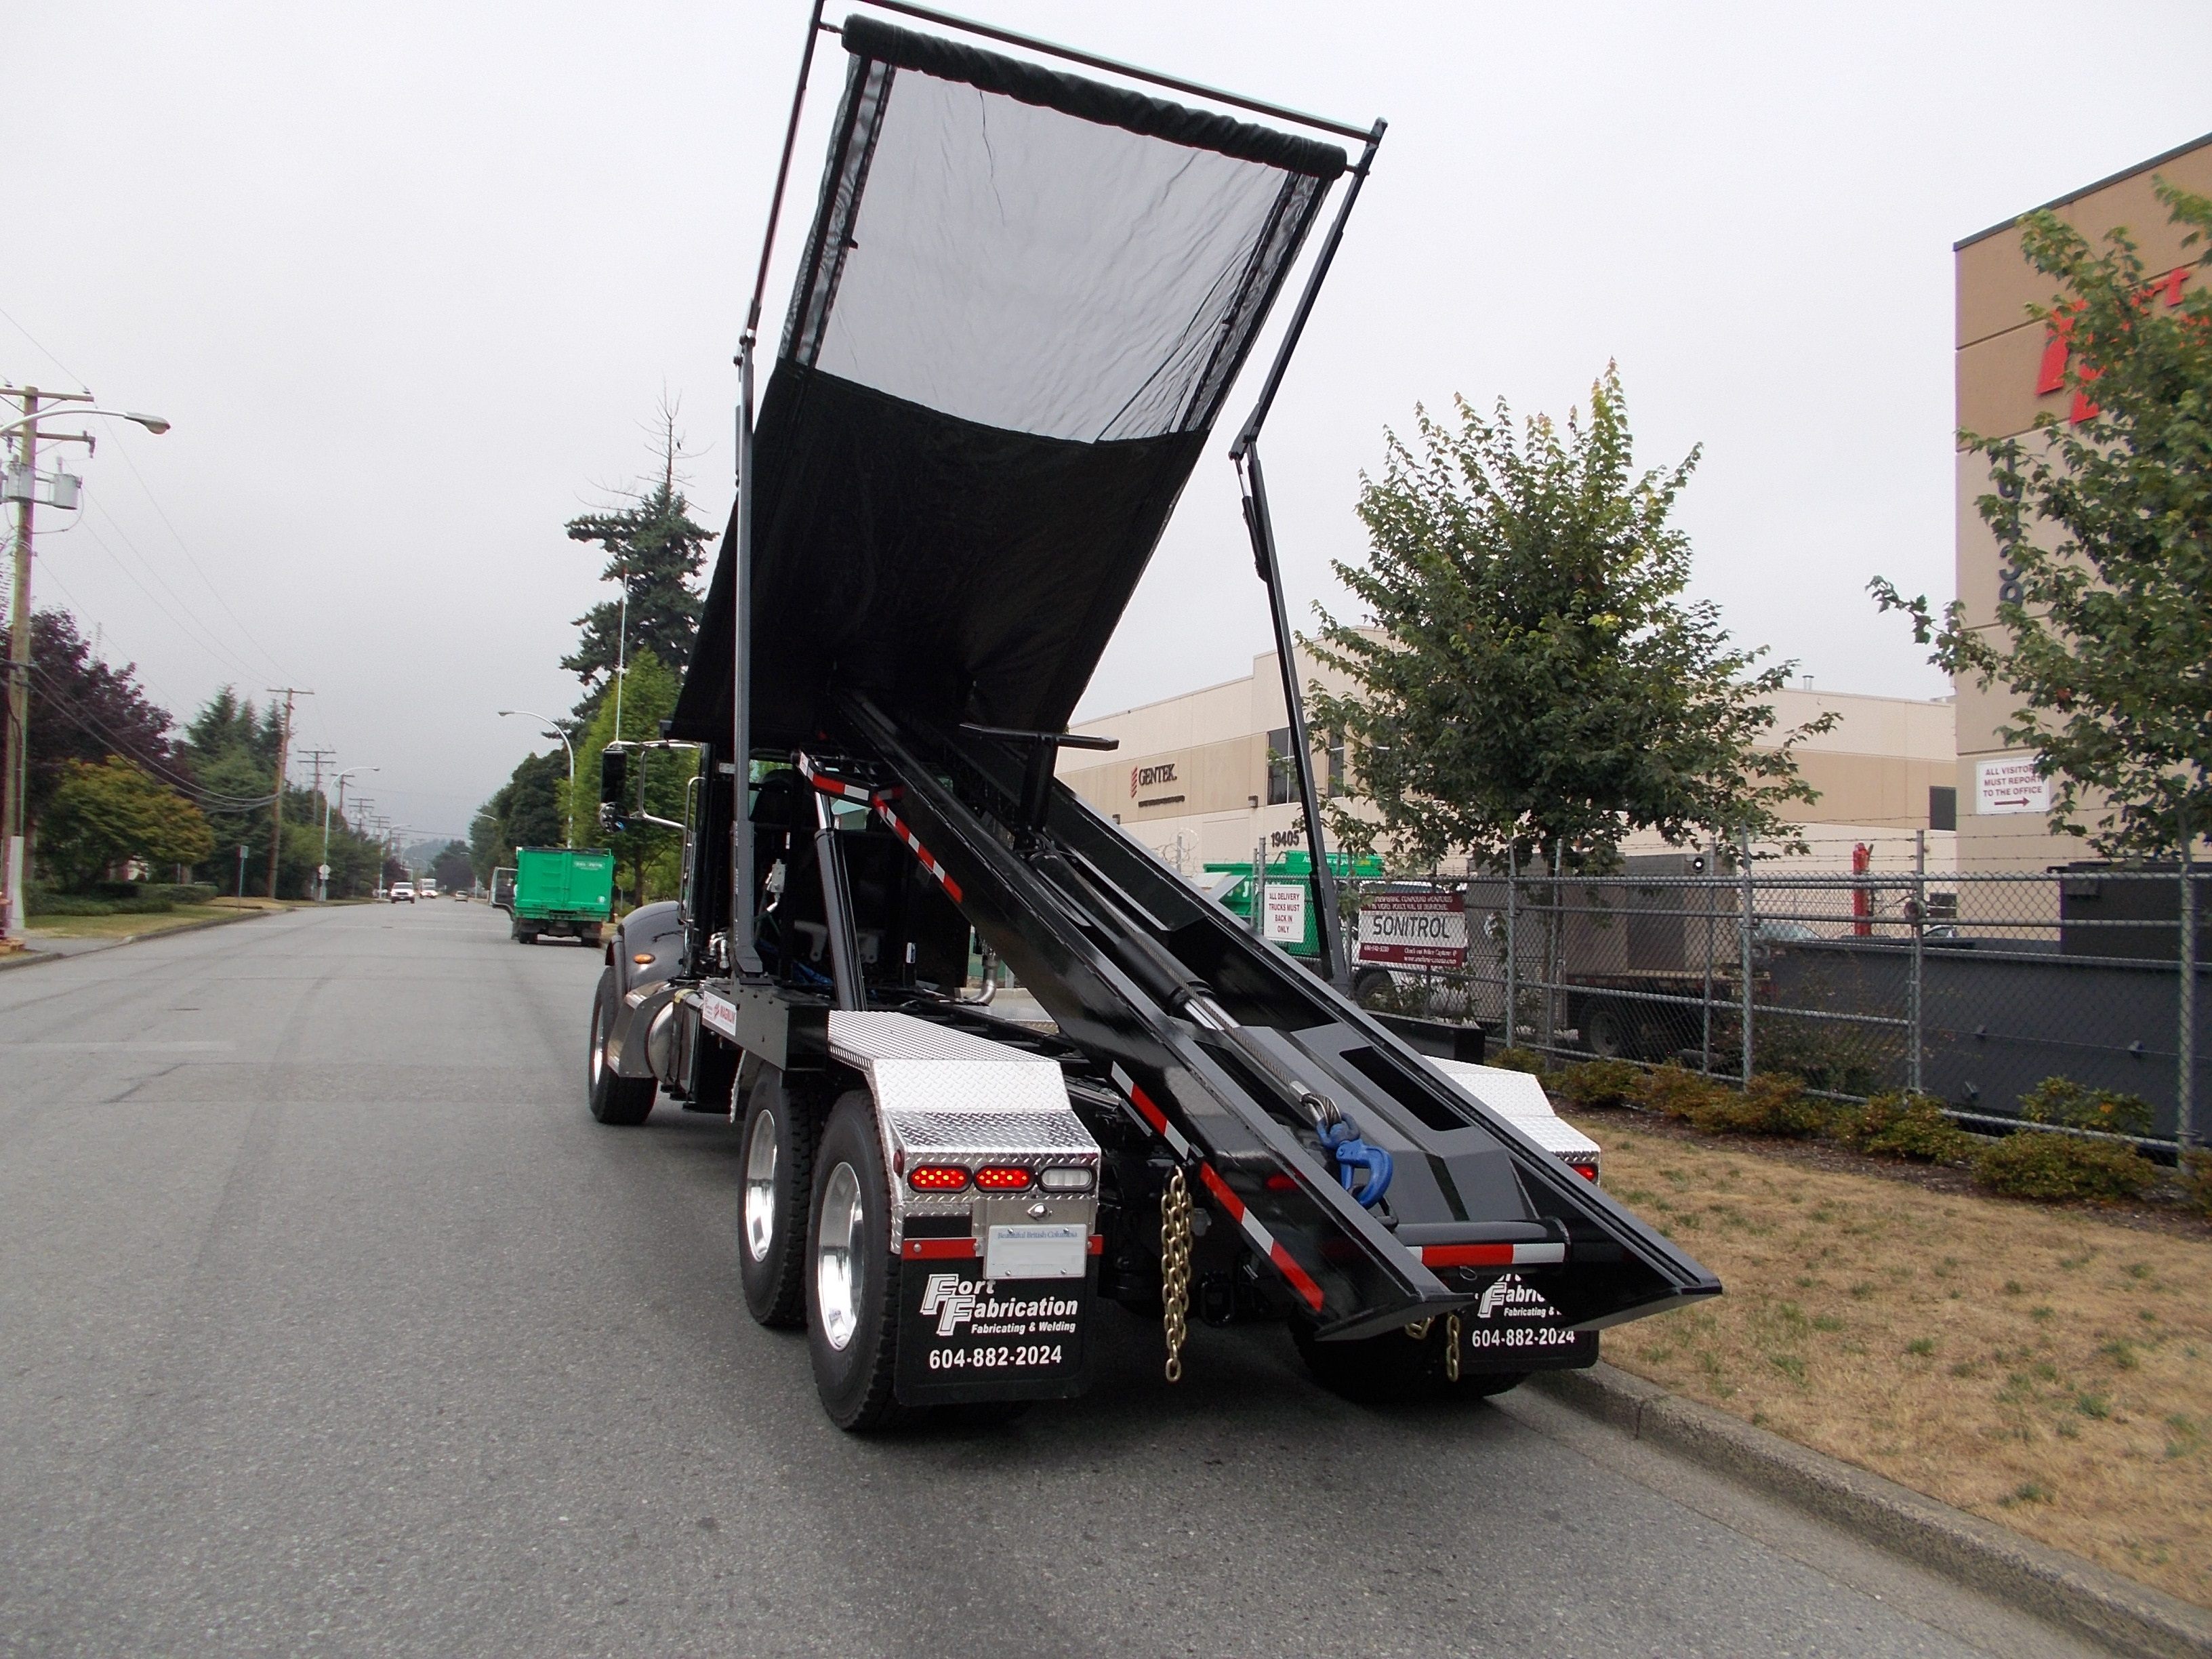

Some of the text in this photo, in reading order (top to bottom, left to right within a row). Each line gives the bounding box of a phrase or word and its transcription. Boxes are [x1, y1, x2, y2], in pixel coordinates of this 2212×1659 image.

[2001, 764, 2034, 775] VISITOR
[1984, 775, 2042, 786] MUST REPORT
[2013, 786, 2043, 795] OFFICE
[1271, 830, 1299, 847] 19405
[1277, 925, 1290, 933] ONLY
[1373, 915, 1450, 939] SONITROL
[1027, 1231, 1046, 1239] British
[920, 1274, 996, 1315] Fort
[936, 1295, 1078, 1336] Fabrication
[1503, 1307, 1547, 1317] Fabricating
[1549, 1306, 1555, 1315] &
[971, 1321, 1076, 1334] Fabricating & Welding
[1472, 1327, 1576, 1347] 604-882-2024
[929, 1345, 1062, 1369] 604-882-2024
